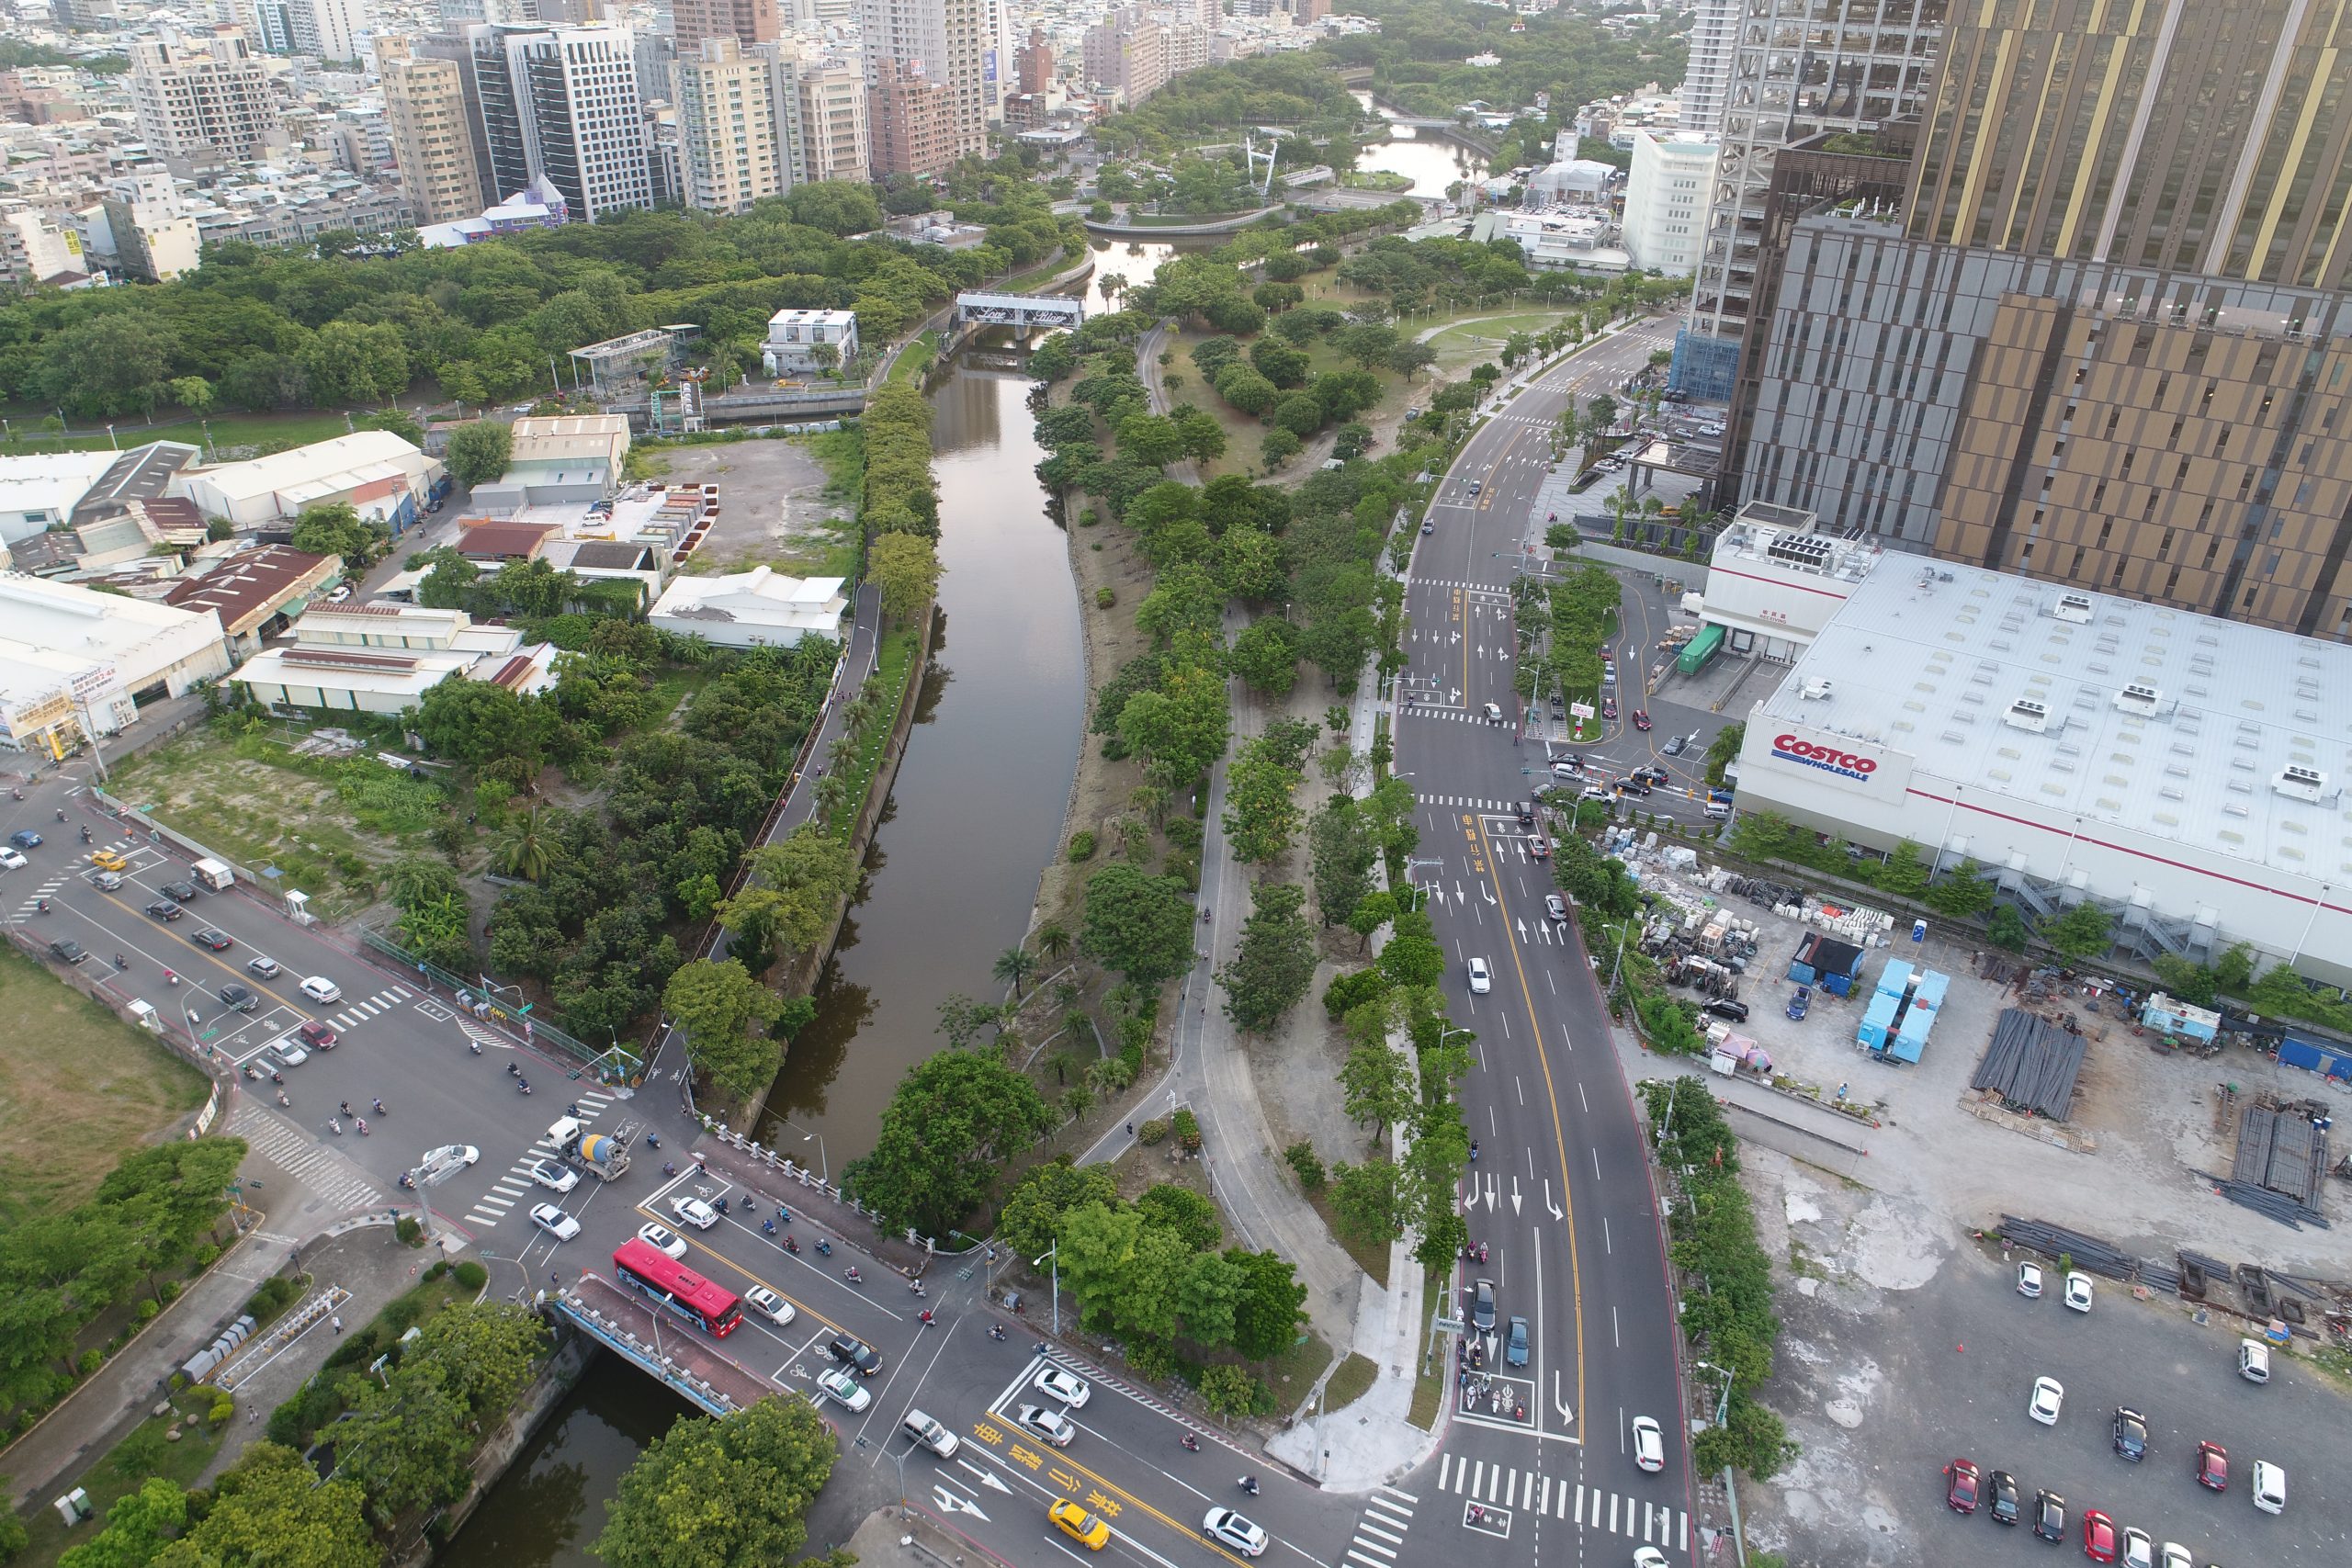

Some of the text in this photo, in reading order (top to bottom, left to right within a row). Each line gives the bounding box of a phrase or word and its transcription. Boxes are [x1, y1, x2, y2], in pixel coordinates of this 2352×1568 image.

[1759, 614, 1787, 625] RECEIVING
[1773, 734, 1877, 773] COSTCO
[1802, 757, 1869, 783] WHOLESALE
[1462, 814, 1485, 873] 禁行機車
[974, 1423, 1123, 1517] 禁行機車
